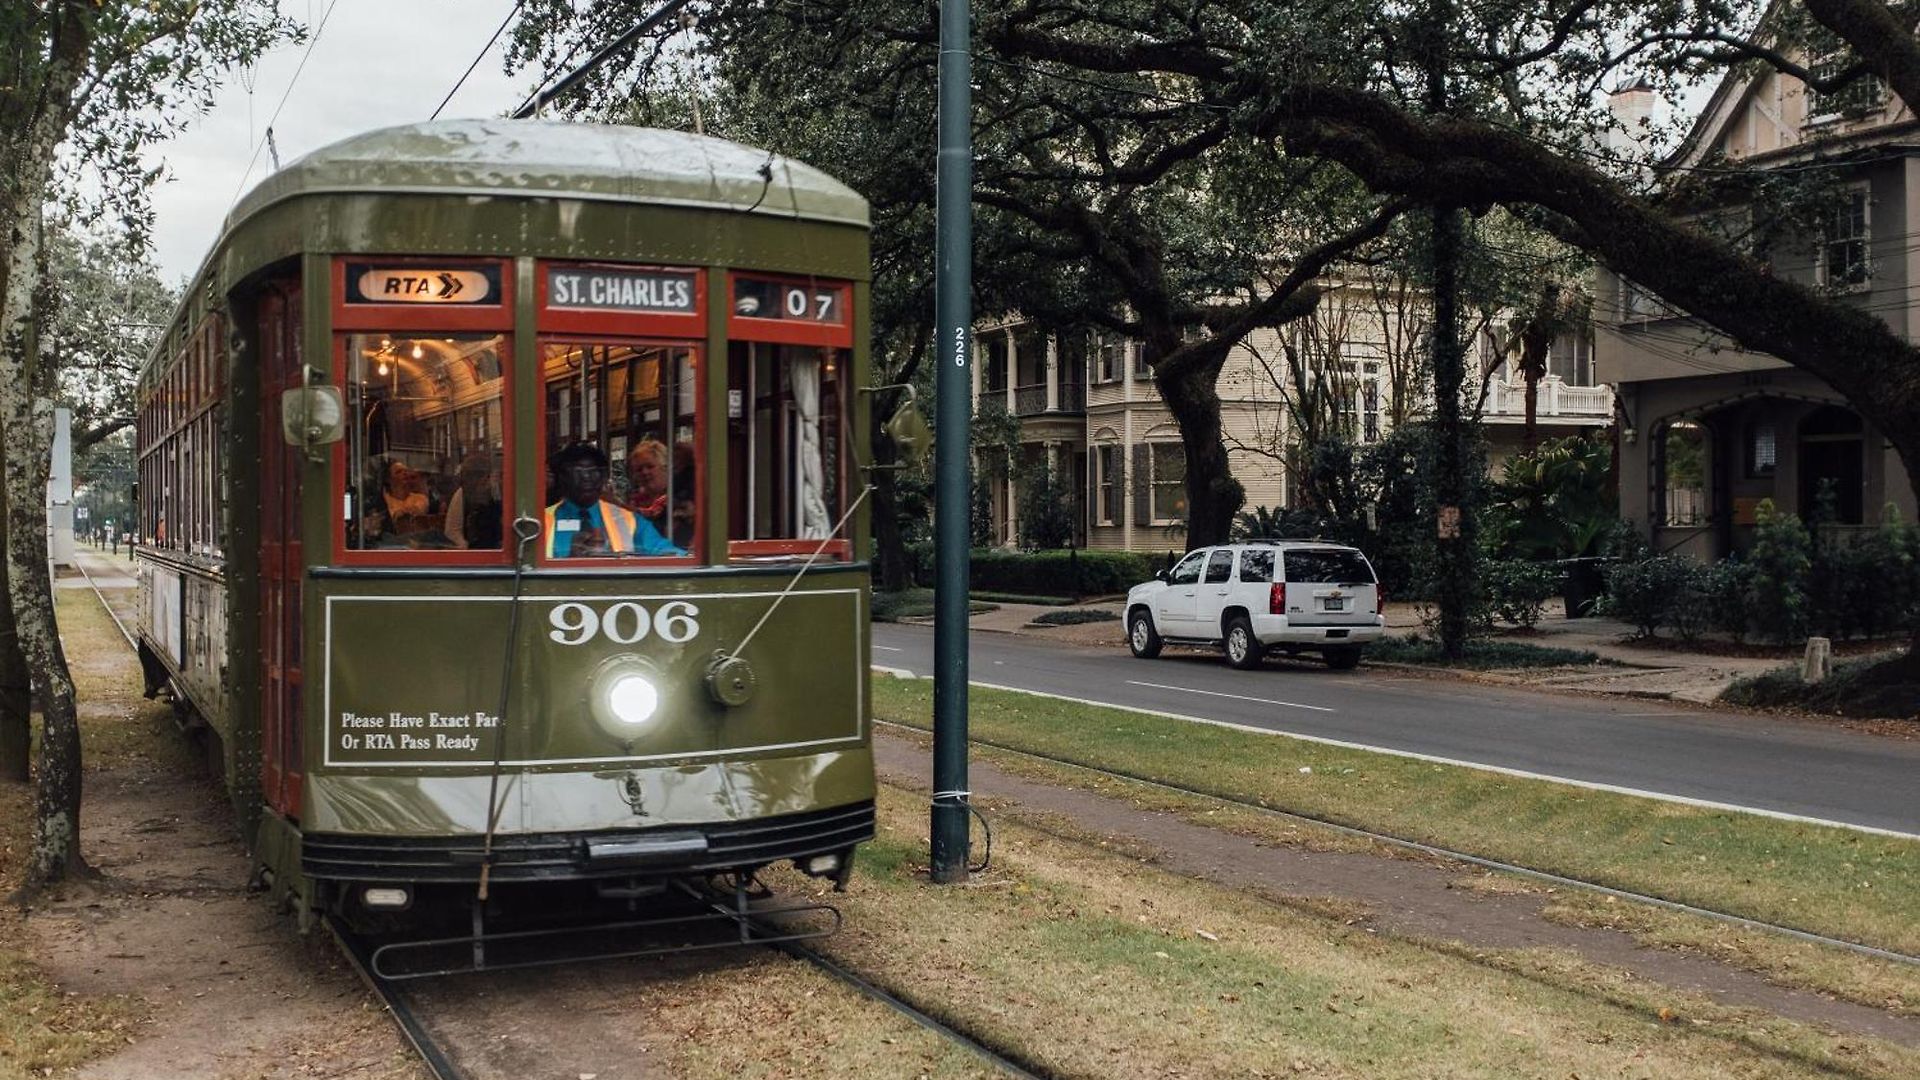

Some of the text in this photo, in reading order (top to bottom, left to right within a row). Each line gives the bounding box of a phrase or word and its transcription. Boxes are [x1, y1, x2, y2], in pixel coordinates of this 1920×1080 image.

[384, 277, 430, 294] RTA
[554, 275, 690, 307] ST. CHARLES
[955, 327, 965, 367] 226
[549, 601, 700, 646] 906
[341, 712, 505, 728] Please Have Exact Far
[341, 734, 480, 751] Or RTA Pass Ready
